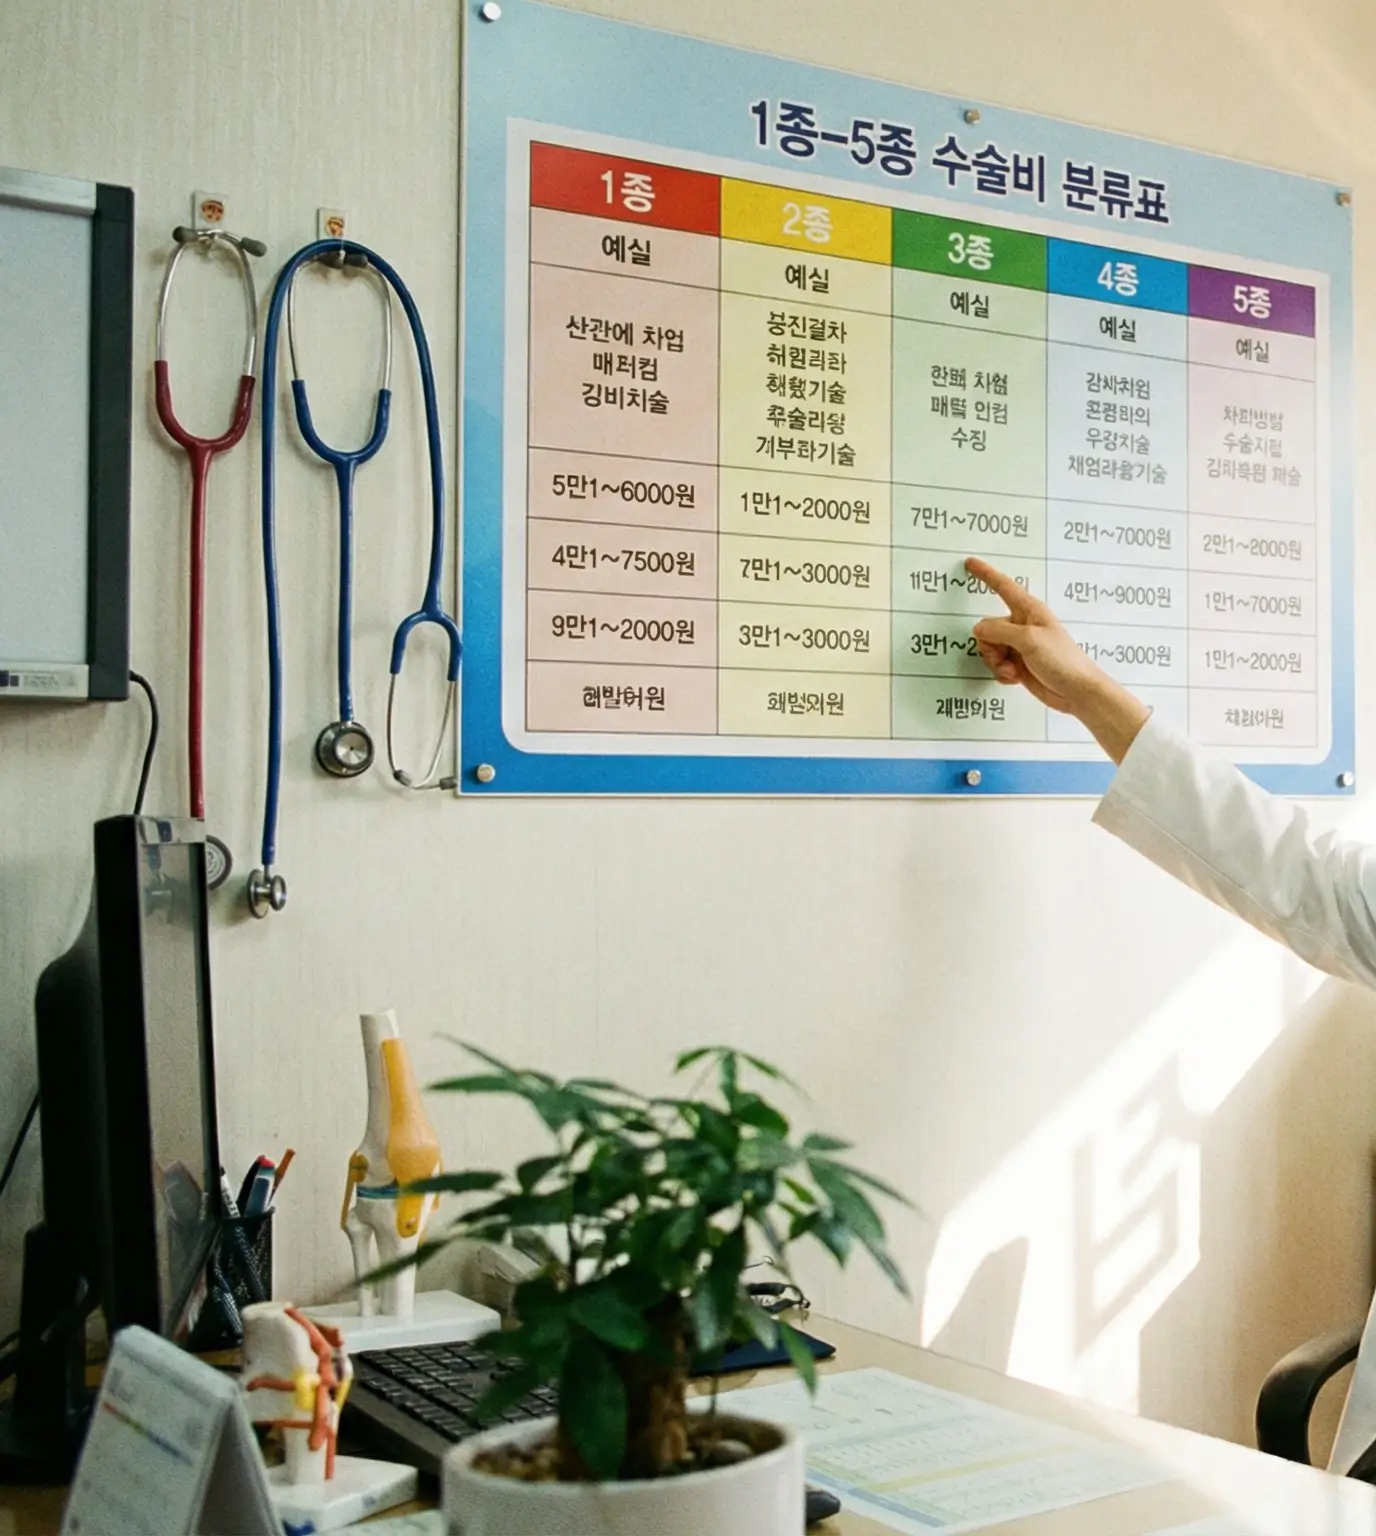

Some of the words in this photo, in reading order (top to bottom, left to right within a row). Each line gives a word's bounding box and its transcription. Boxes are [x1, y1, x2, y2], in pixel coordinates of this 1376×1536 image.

[601, 171, 655, 212] 1종
[933, 136, 1044, 202] 수술비
[1063, 162, 1168, 223] 분류표
[783, 203, 832, 244] 2종
[602, 235, 650, 266] 예실
[948, 233, 993, 270] 3종
[785, 265, 829, 293] 예실
[1098, 262, 1139, 296] 4종
[950, 292, 988, 318] 예실
[1234, 286, 1271, 318] 5종
[1100, 317, 1136, 342] 예실
[1236, 339, 1268, 363] 예실
[553, 475, 694, 508] 5만1~6000원
[741, 492, 869, 524] 1만1~2000원
[911, 507, 1027, 537] 7만1~7000원
[1064, 521, 1170, 550] 2만1~7000원
[1203, 534, 1301, 560] 2만1~2000원
[552, 545, 694, 576] 4만1~7500원
[740, 559, 869, 588] 7만1~3000원
[1064, 582, 1170, 608] 4만1~9000원
[1205, 592, 1301, 617] 1만1~7000원
[552, 615, 694, 644] 9만1~2000원
[739, 625, 869, 652] 3만1~3000원
[1205, 650, 1301, 673] 1만1~2000원
